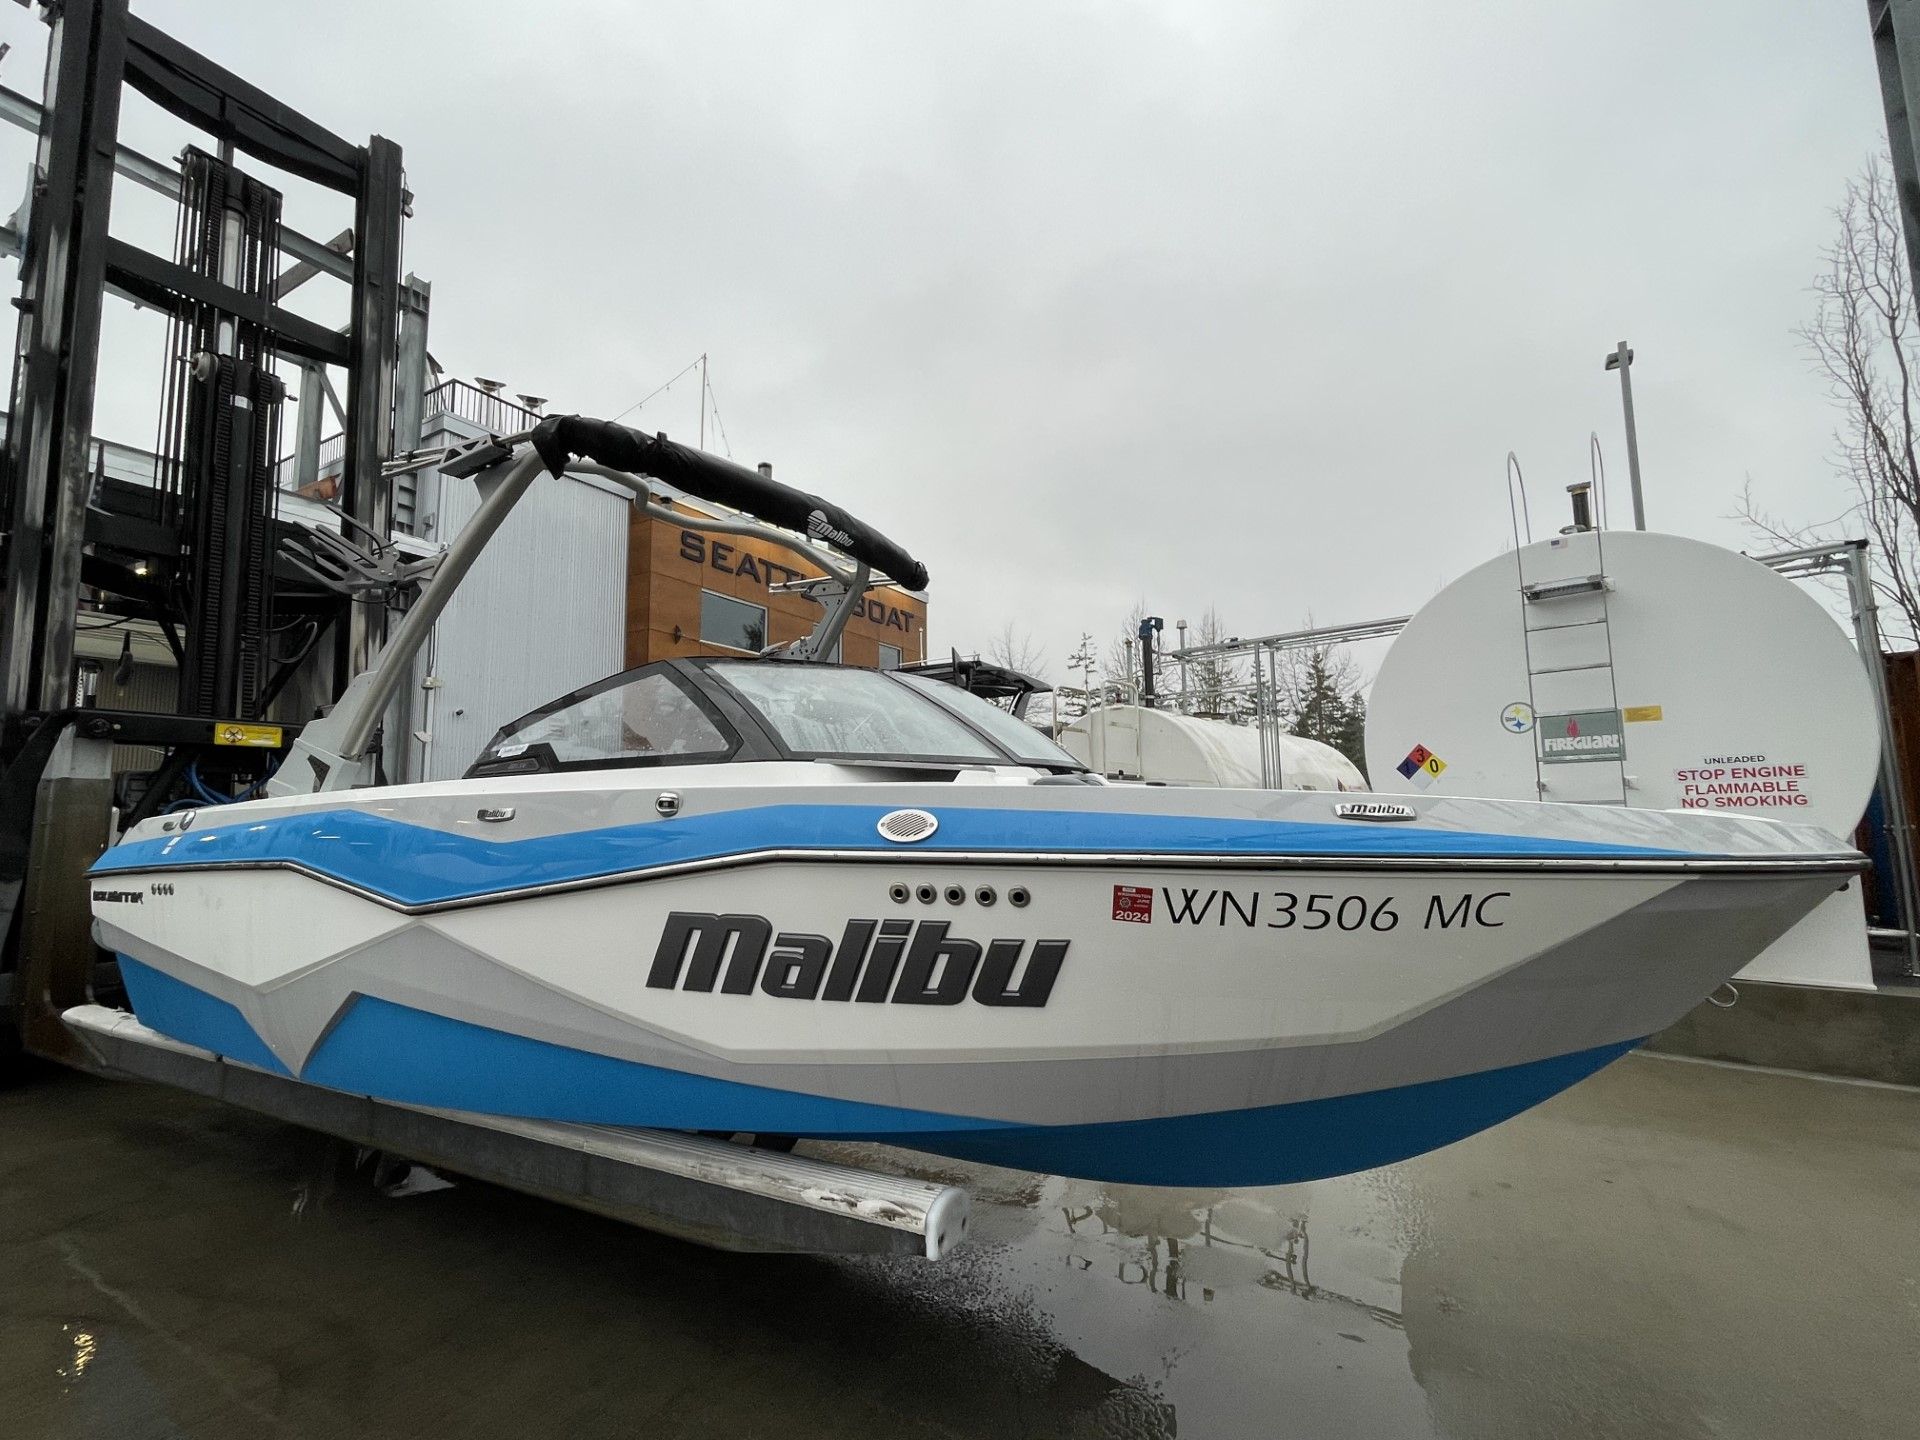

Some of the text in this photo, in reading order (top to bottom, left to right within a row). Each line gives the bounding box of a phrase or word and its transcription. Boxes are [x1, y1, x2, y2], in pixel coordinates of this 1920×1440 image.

[680, 530, 807, 588] SEATT
[1416, 748, 1426, 763] 3
[1704, 755, 1766, 765] UNLEADED
[1429, 758, 1439, 773] 0
[1677, 765, 1806, 781] STOP ENGINE
[1684, 780, 1799, 796] FLAMMABLE
[1681, 794, 1809, 809] NO SMOKING
[1115, 910, 1149, 922] 2024
[1424, 892, 1511, 930] MC
